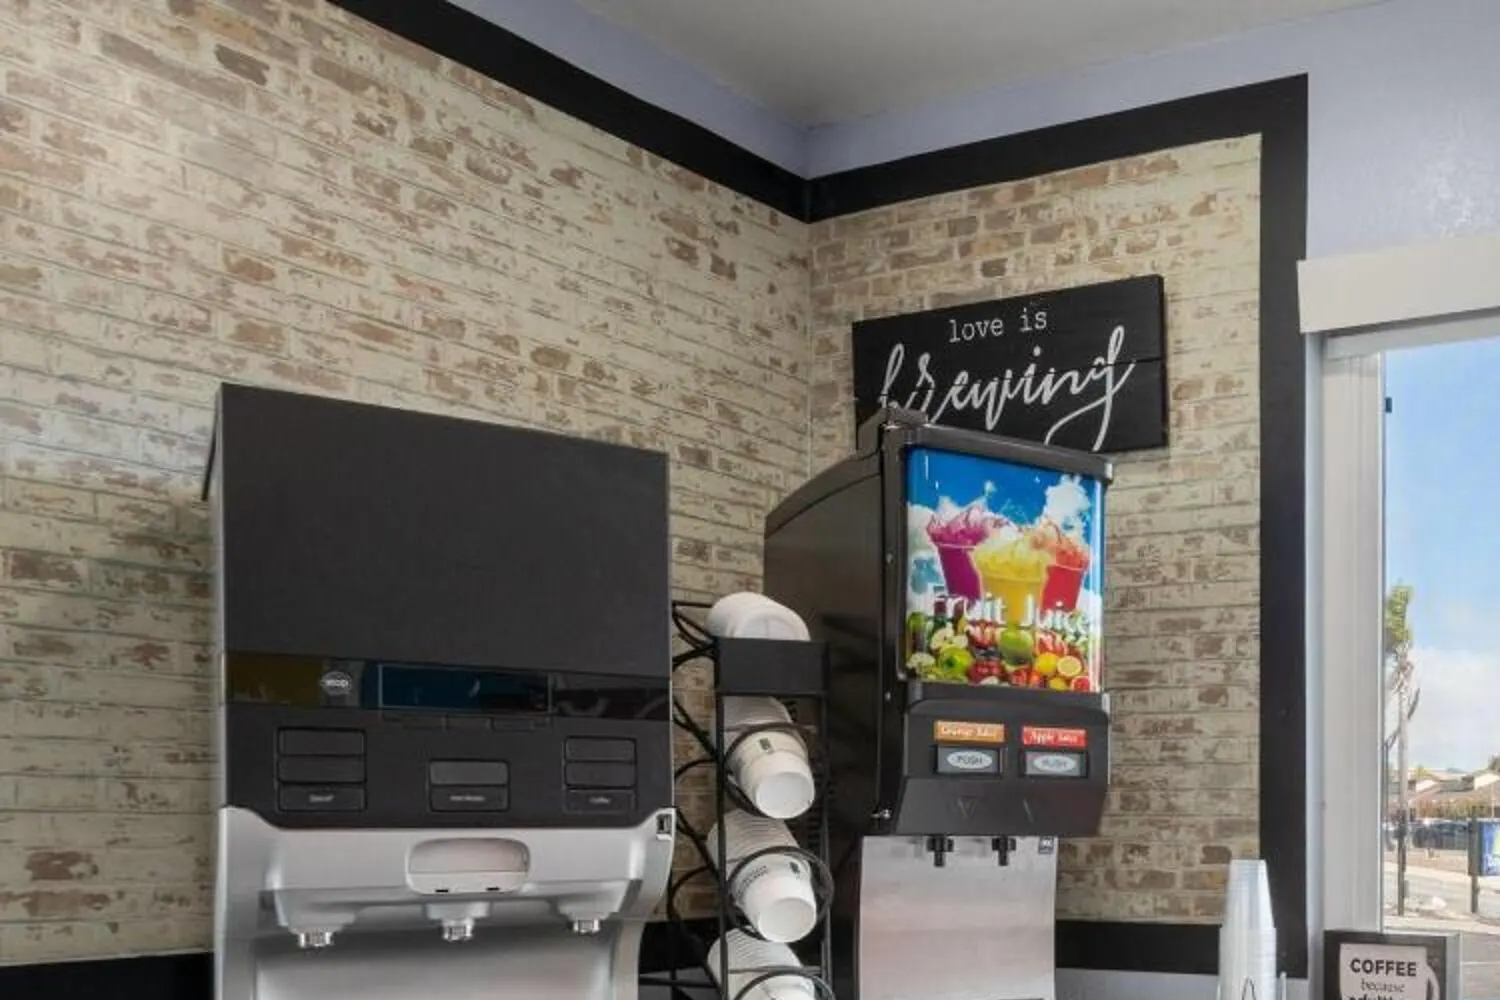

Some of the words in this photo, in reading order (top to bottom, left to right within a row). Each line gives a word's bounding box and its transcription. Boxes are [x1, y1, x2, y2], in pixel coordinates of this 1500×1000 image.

[948, 316, 1005, 344] love
[1019, 308, 1048, 332] is
[1350, 958, 1417, 977] COFFEE
